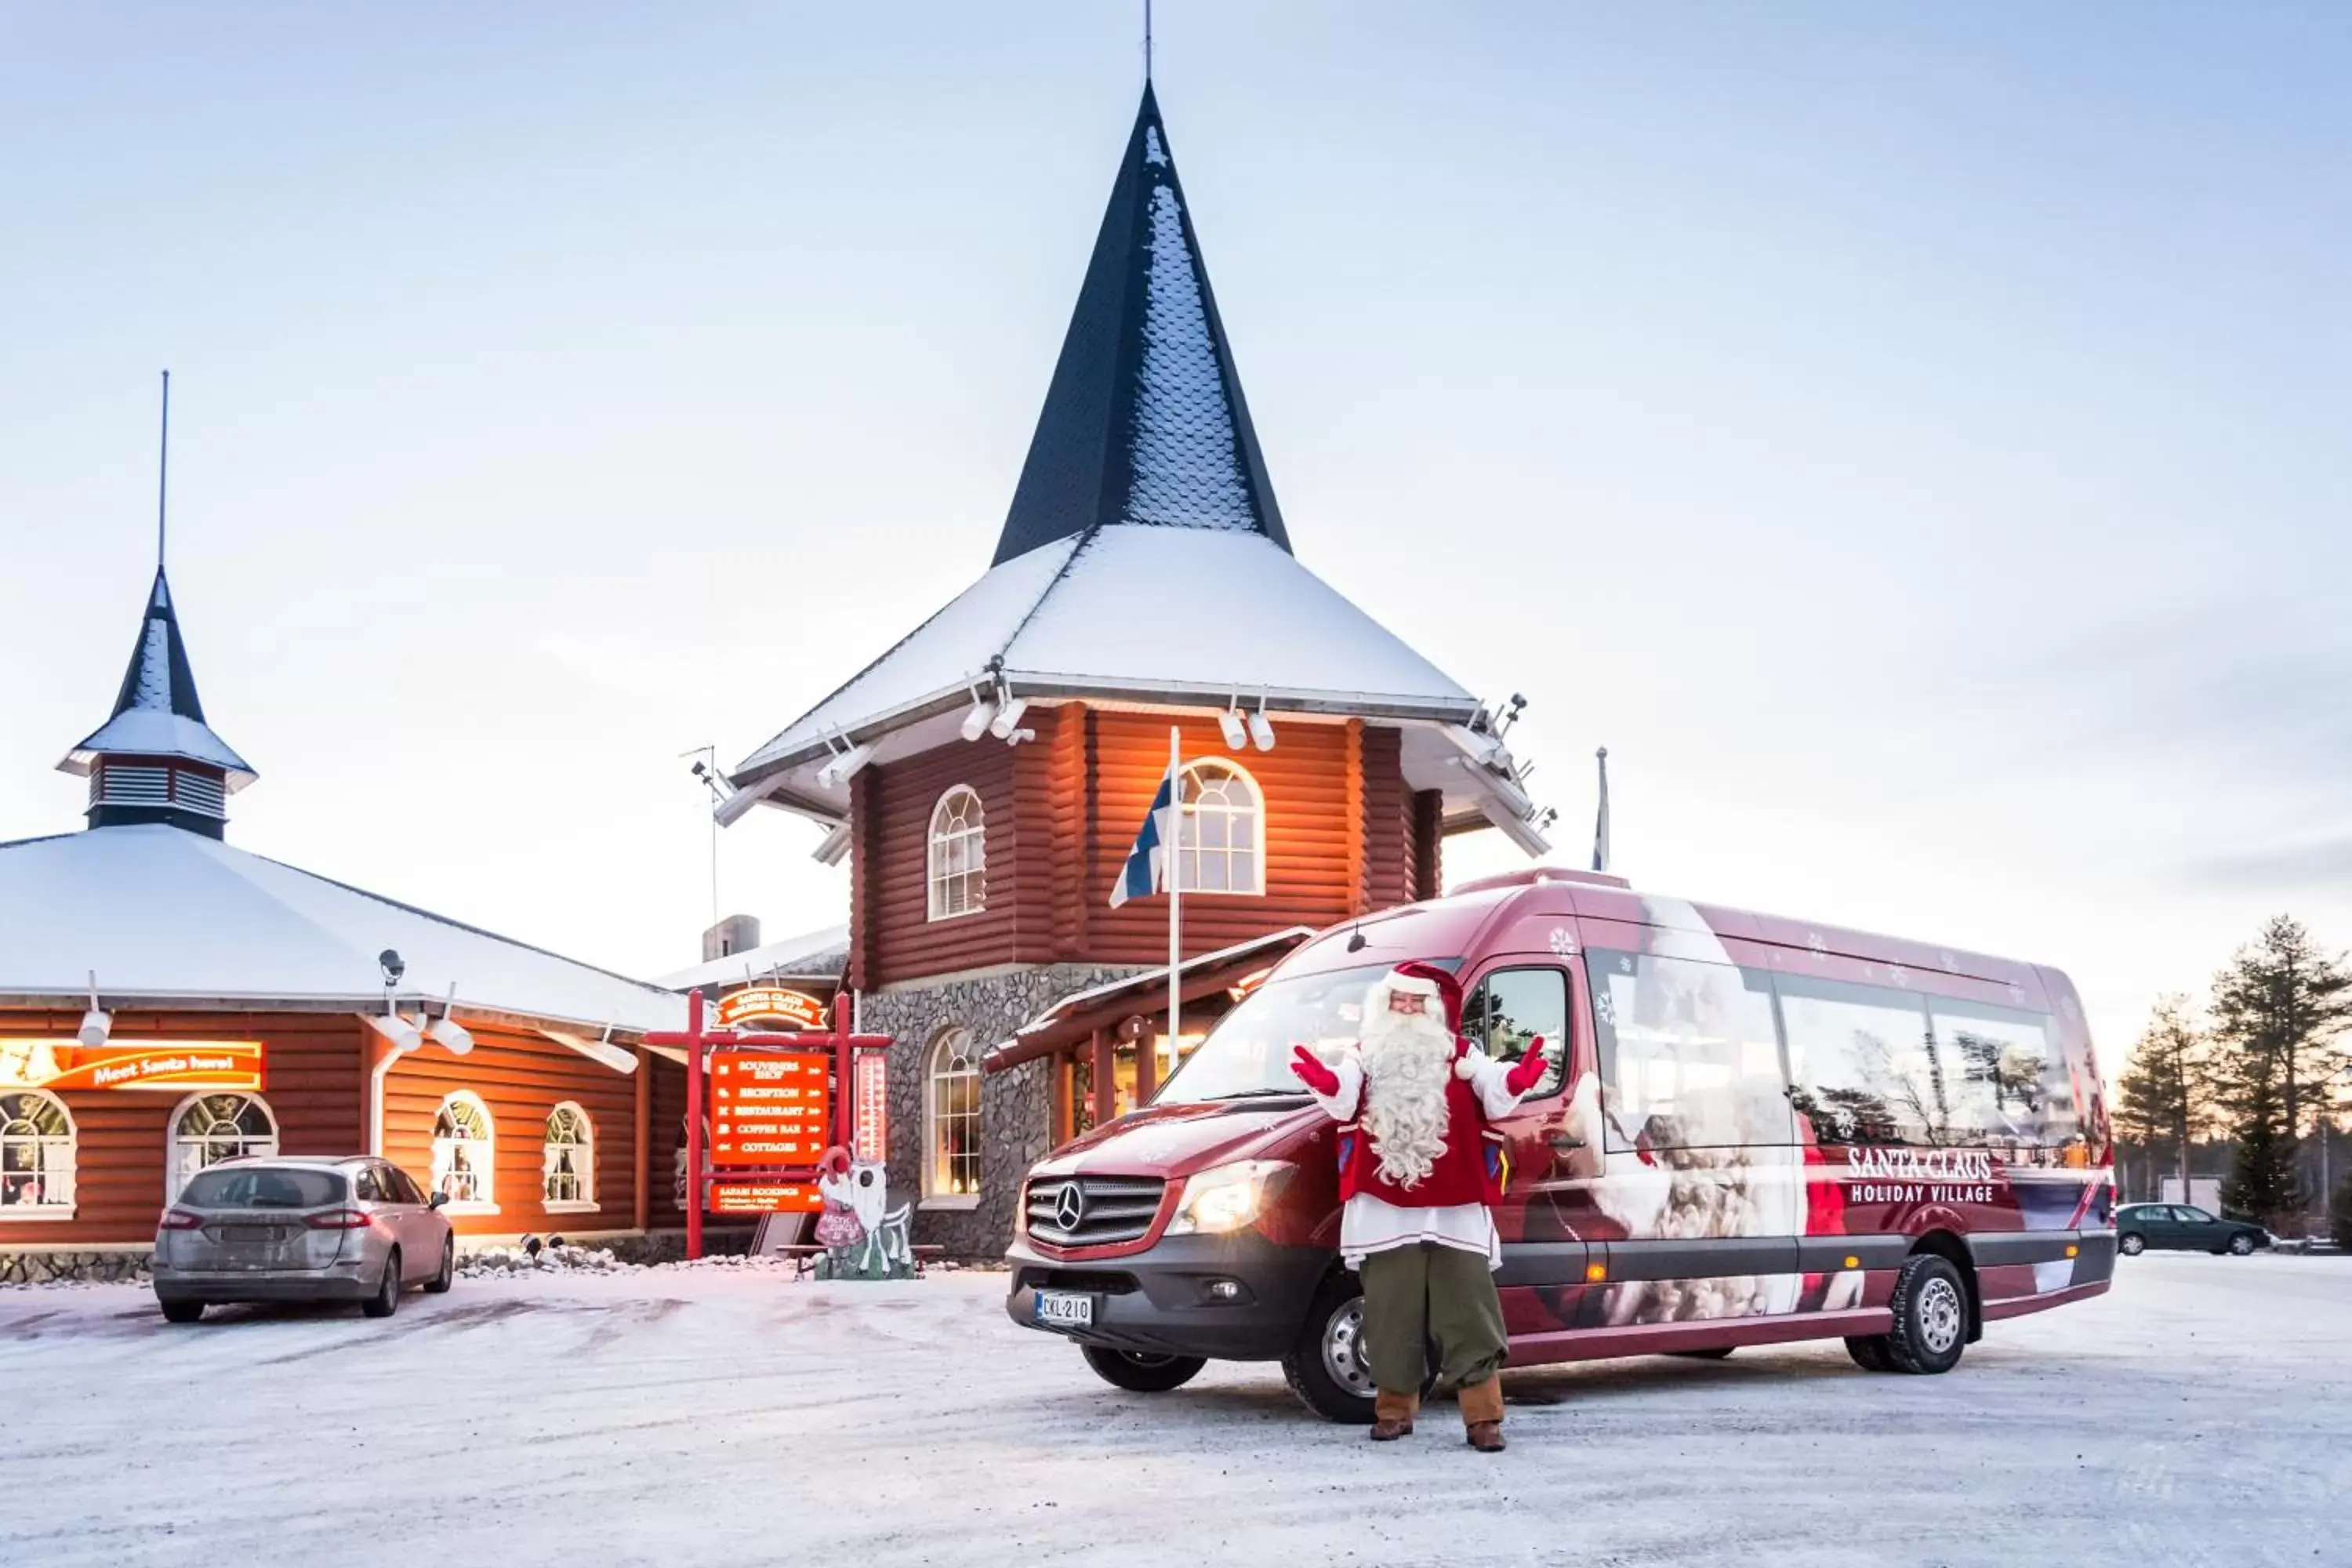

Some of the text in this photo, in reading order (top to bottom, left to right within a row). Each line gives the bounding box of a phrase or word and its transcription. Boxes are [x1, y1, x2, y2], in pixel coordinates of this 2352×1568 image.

[94, 1062, 139, 1085] Meet
[140, 1058, 187, 1073] Santa
[734, 1106, 804, 1116] RESTAURANT
[737, 1124, 778, 1134] COFFEE
[1848, 1147, 1991, 1181] SANTA CLAUS
[1852, 1185, 1993, 1203] HOLIDAY VILLAGE
[1044, 1298, 1088, 1319] CKL-210
